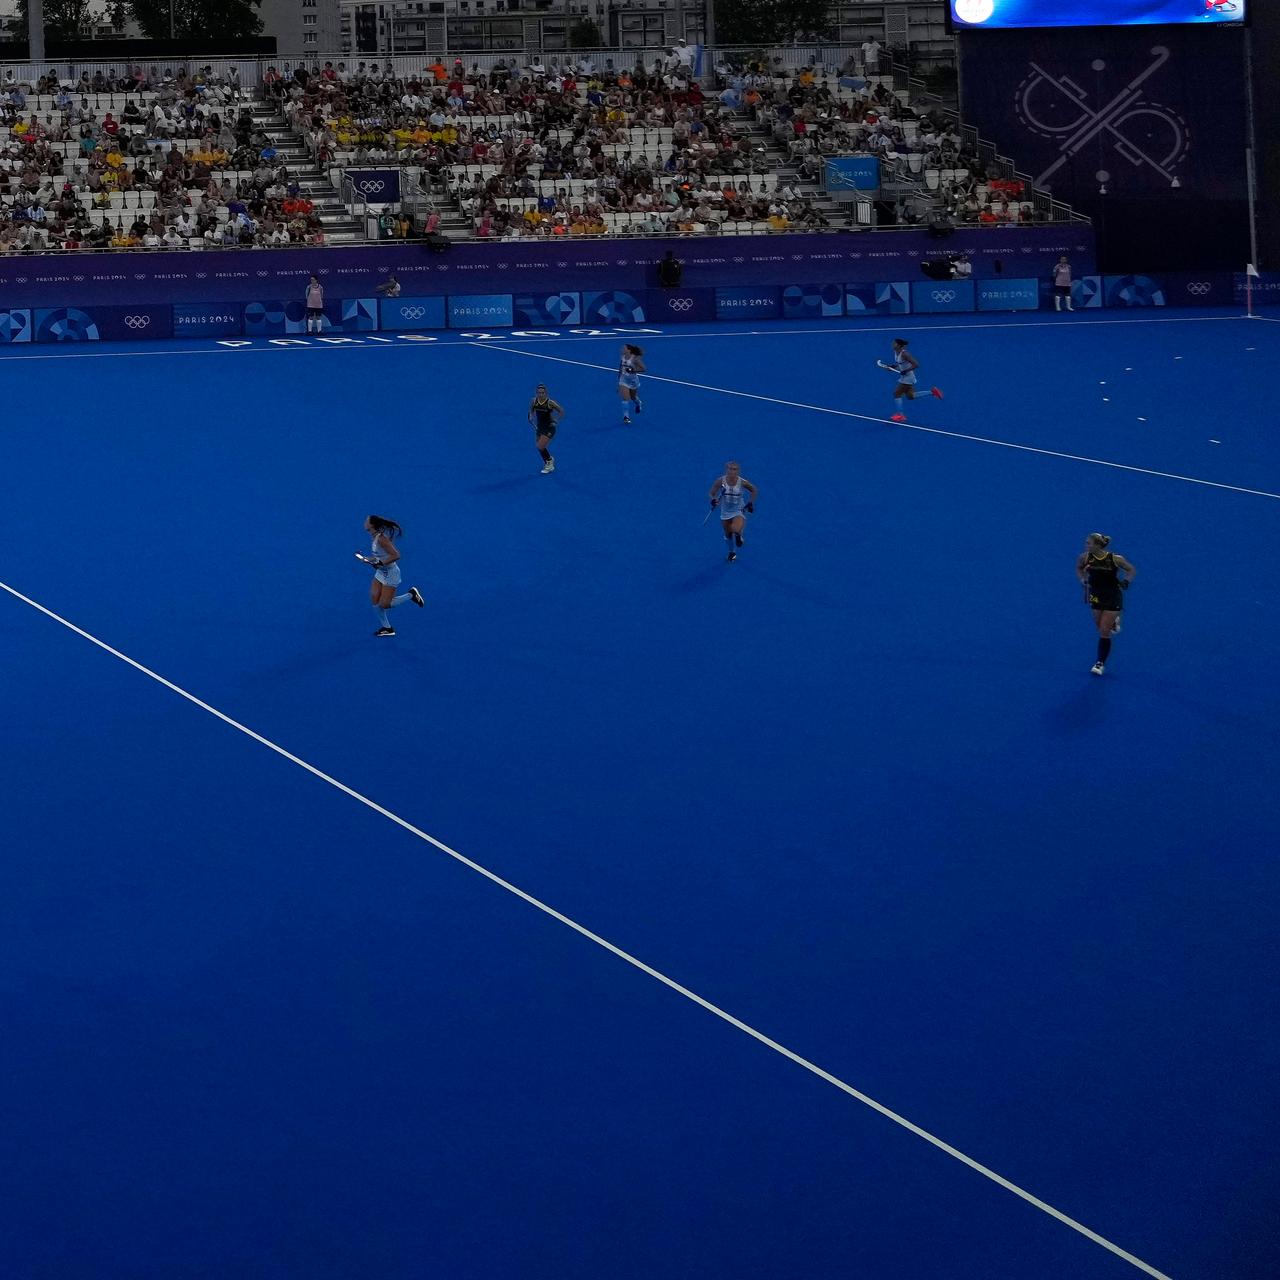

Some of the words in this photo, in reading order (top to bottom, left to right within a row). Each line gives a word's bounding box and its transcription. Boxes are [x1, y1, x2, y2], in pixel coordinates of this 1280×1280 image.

[720, 299, 747, 307] PARIS
[749, 298, 774, 306] 2024
[453, 307, 481, 315] PARIS
[483, 307, 508, 315] 2024
[179, 316, 207, 324] PARIS
[209, 315, 235, 323] 2024
[215, 334, 438, 347] PARIS
[459, 328, 663, 339] 2024
